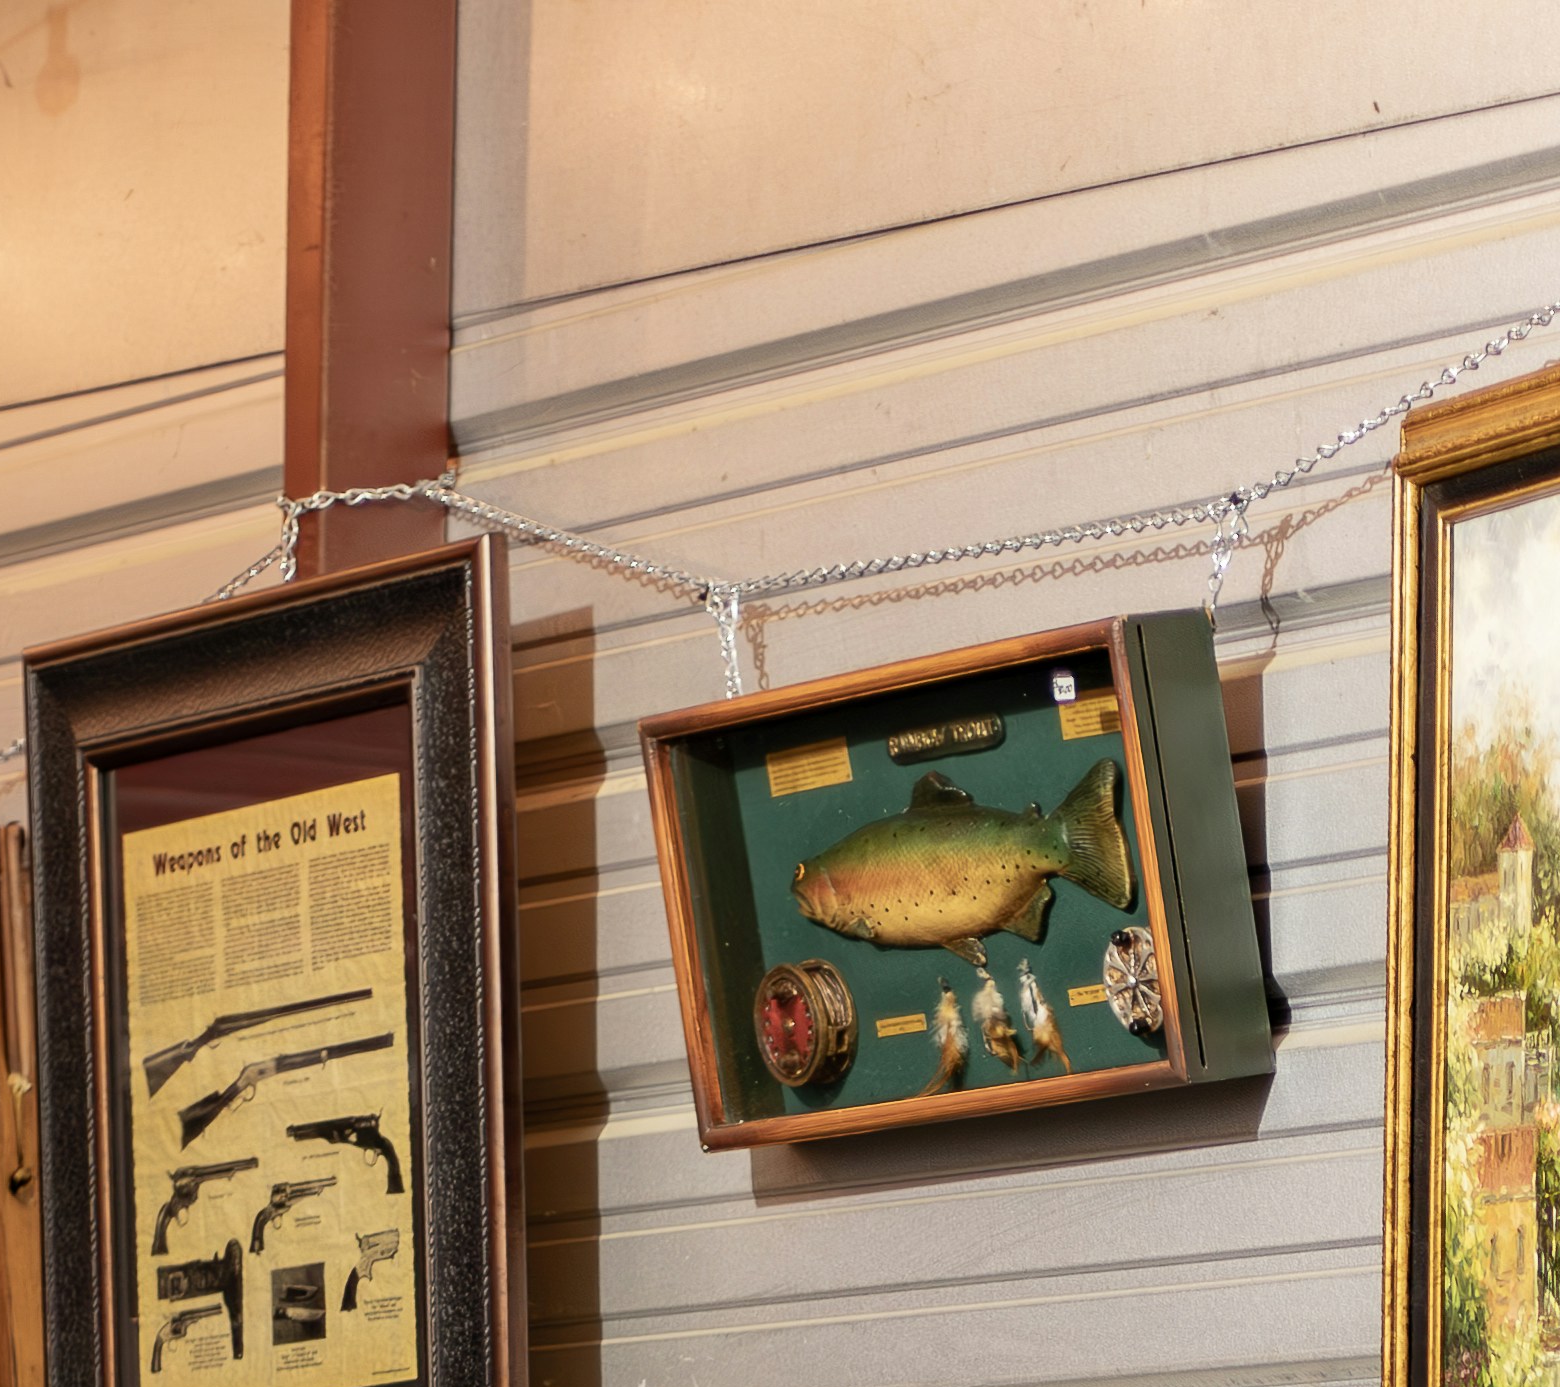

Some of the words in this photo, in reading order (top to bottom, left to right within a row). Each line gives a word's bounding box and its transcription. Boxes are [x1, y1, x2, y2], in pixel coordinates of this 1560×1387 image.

[951, 717, 995, 744] TROUT
[152, 845, 222, 878] Weapons
[230, 834, 247, 860] of
[256, 829, 282, 854] the
[290, 818, 317, 845] Old
[326, 809, 367, 838] West
